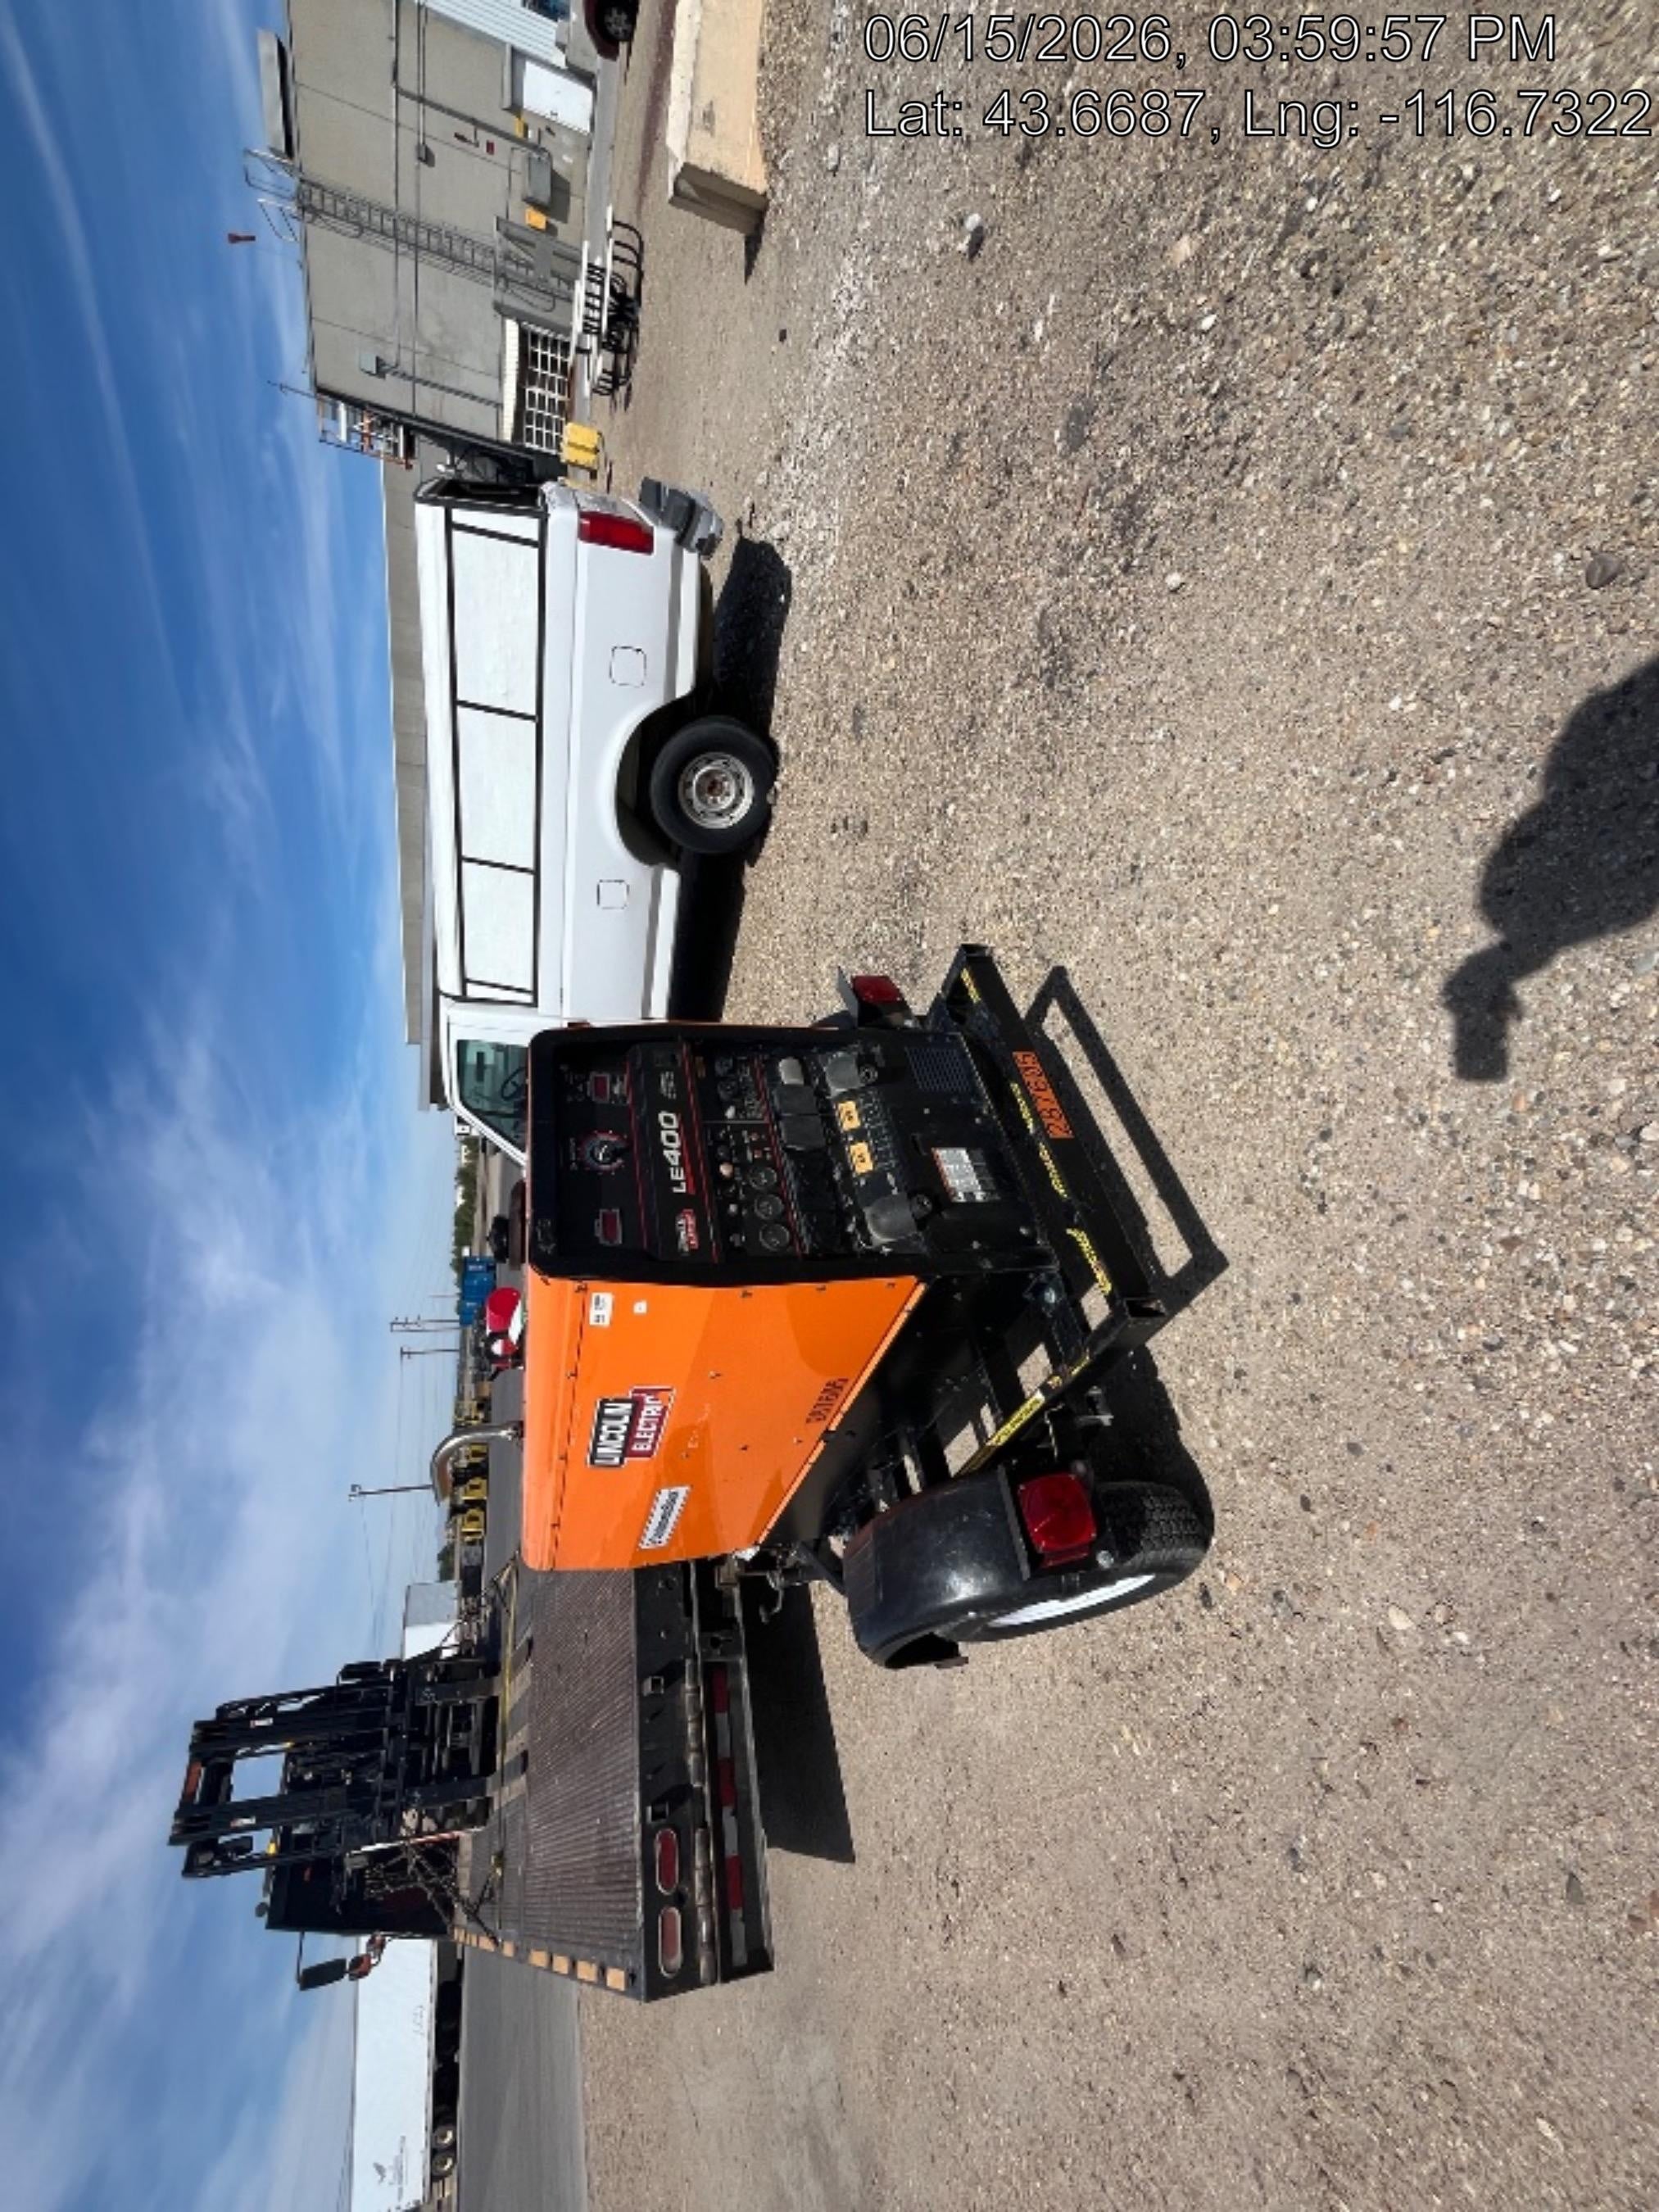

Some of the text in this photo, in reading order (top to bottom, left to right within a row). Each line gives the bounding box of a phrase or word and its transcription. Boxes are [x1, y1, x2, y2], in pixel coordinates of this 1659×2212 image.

[658, 1111, 687, 1193] LE400
[594, 1402, 633, 1465] LINCOLN
[630, 1394, 664, 1451] ELECTRIC
